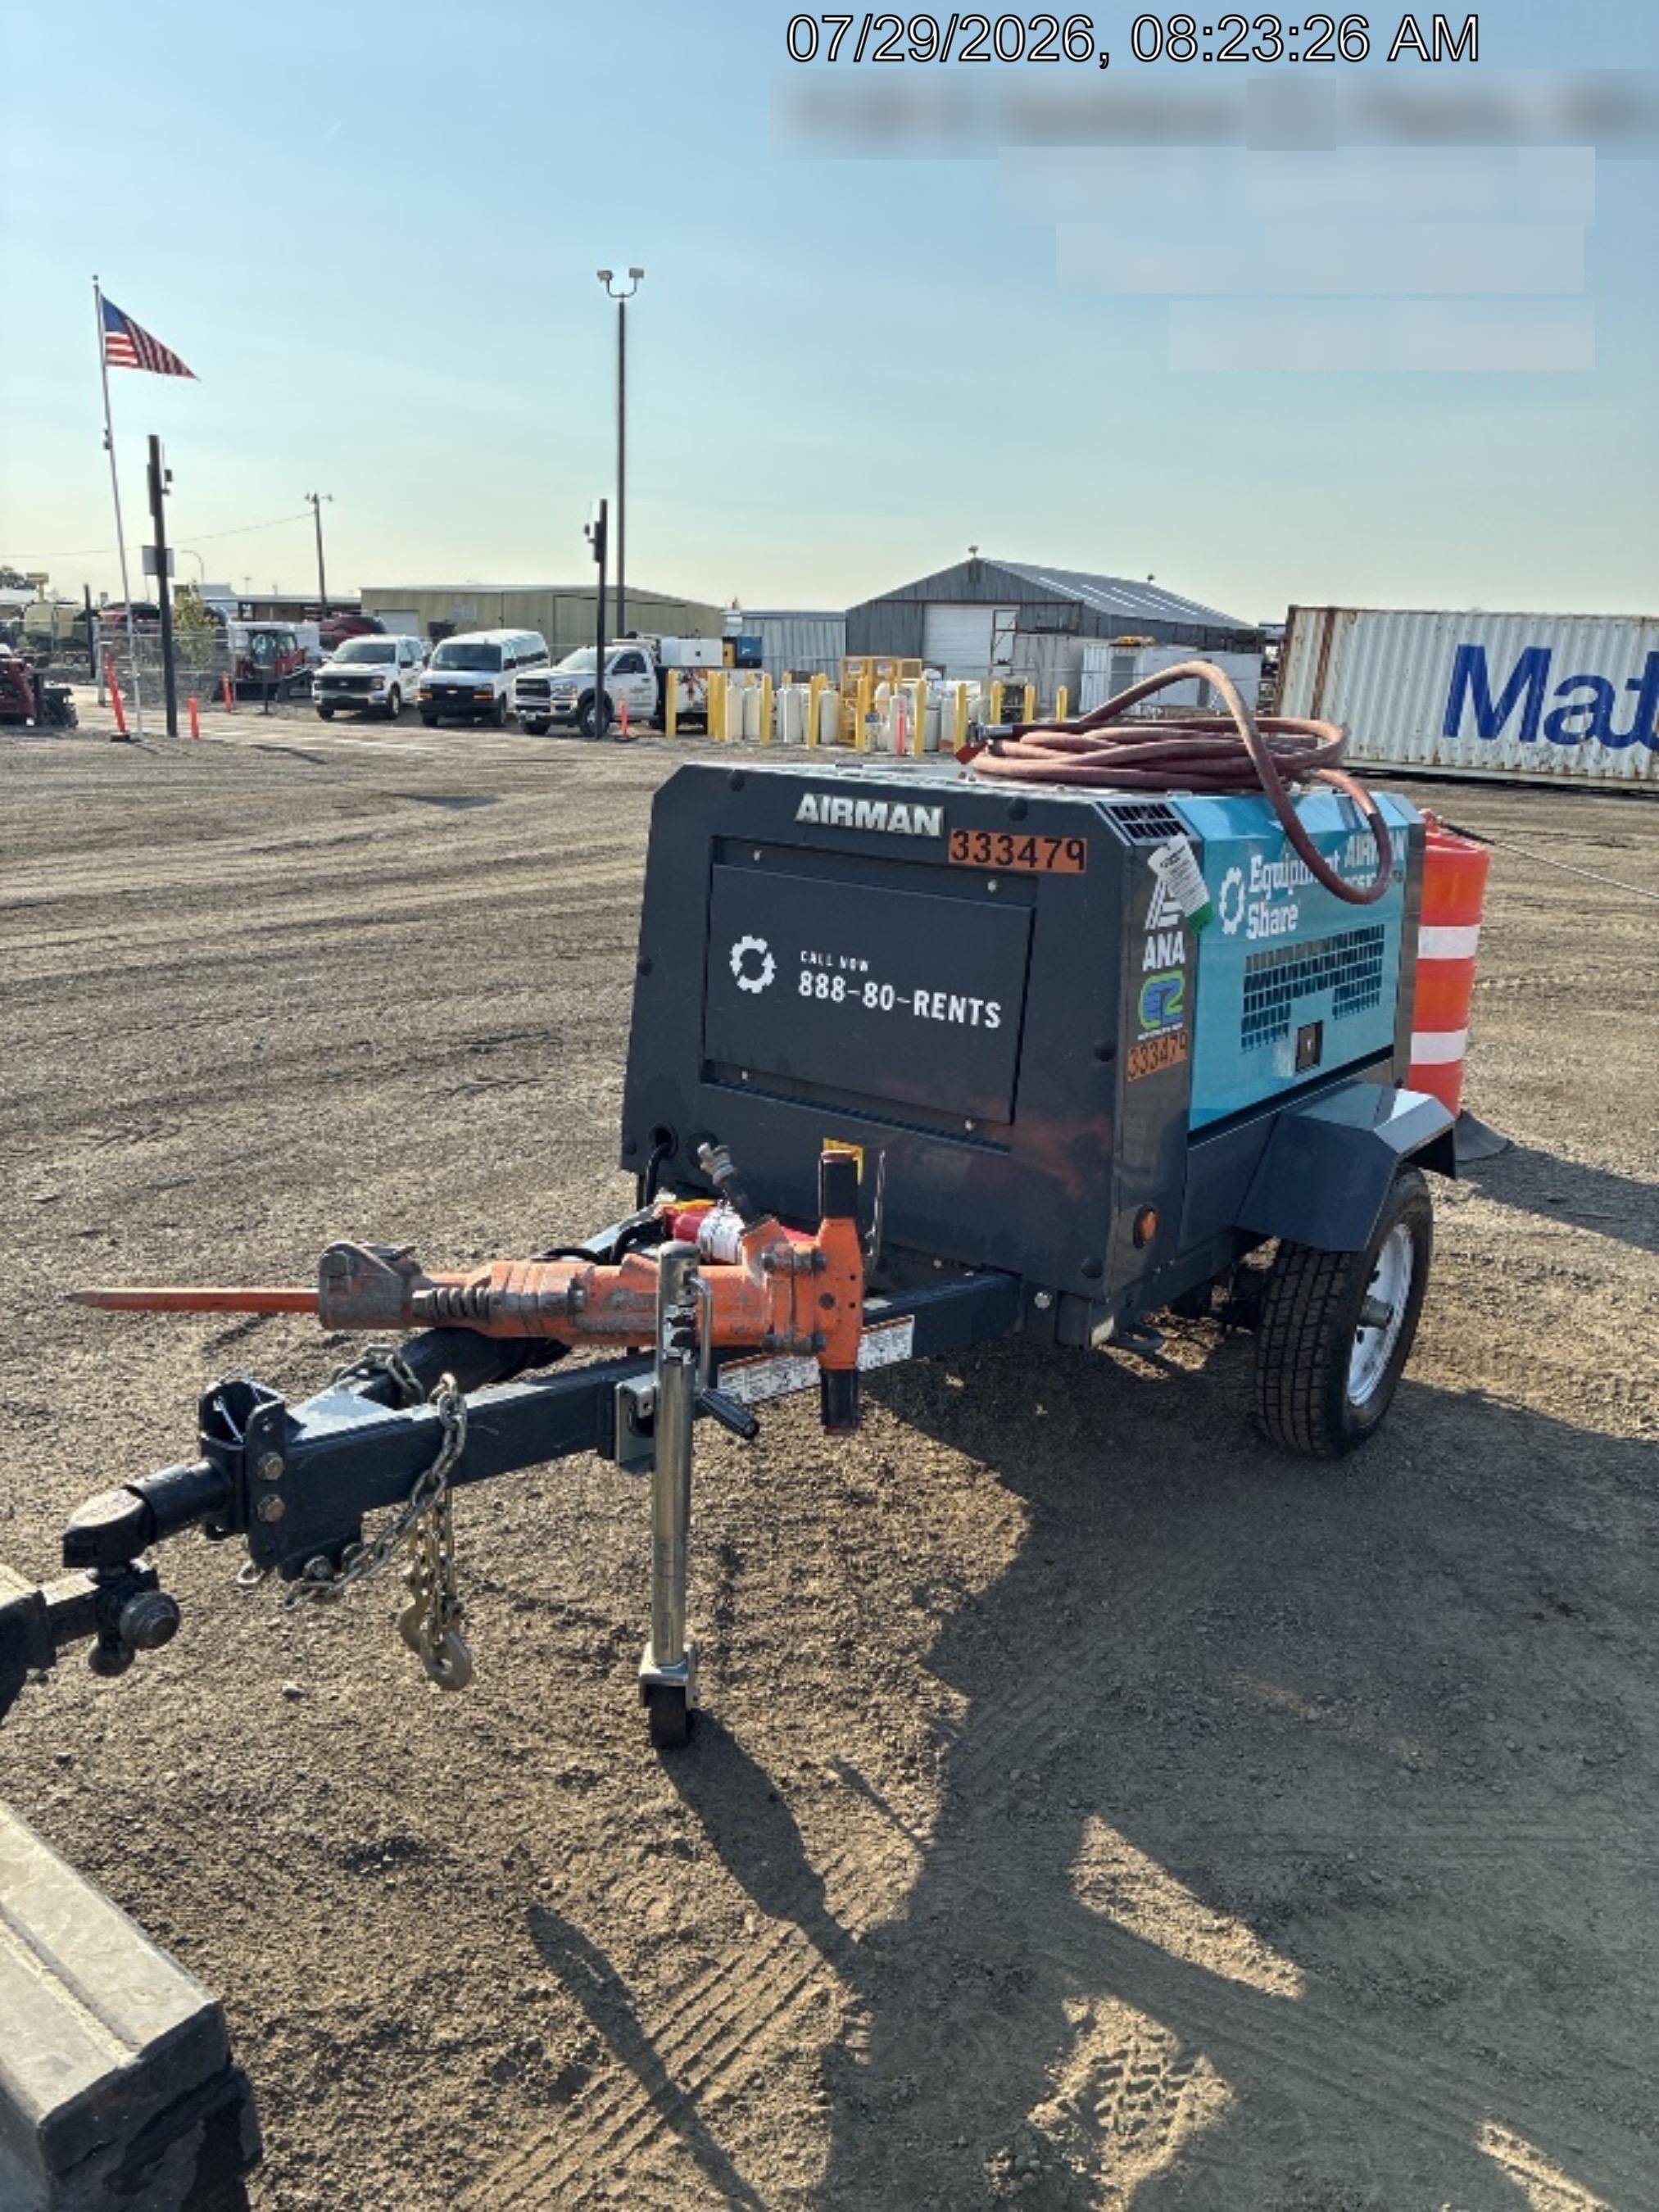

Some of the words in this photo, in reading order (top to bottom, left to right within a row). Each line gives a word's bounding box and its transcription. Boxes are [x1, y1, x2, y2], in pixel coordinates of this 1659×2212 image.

[796, 793, 942, 836] AIRMAN
[951, 830, 1084, 871] 333479
[1249, 850, 1339, 900] Equipmnt
[1246, 902, 1299, 940] Share
[800, 950, 833, 967] CALL
[840, 955, 869, 972] NOW
[1143, 931, 1185, 972] ANA
[799, 970, 1001, 1028] 888-80-RENTS
[1127, 1032, 1187, 1079] 333479
